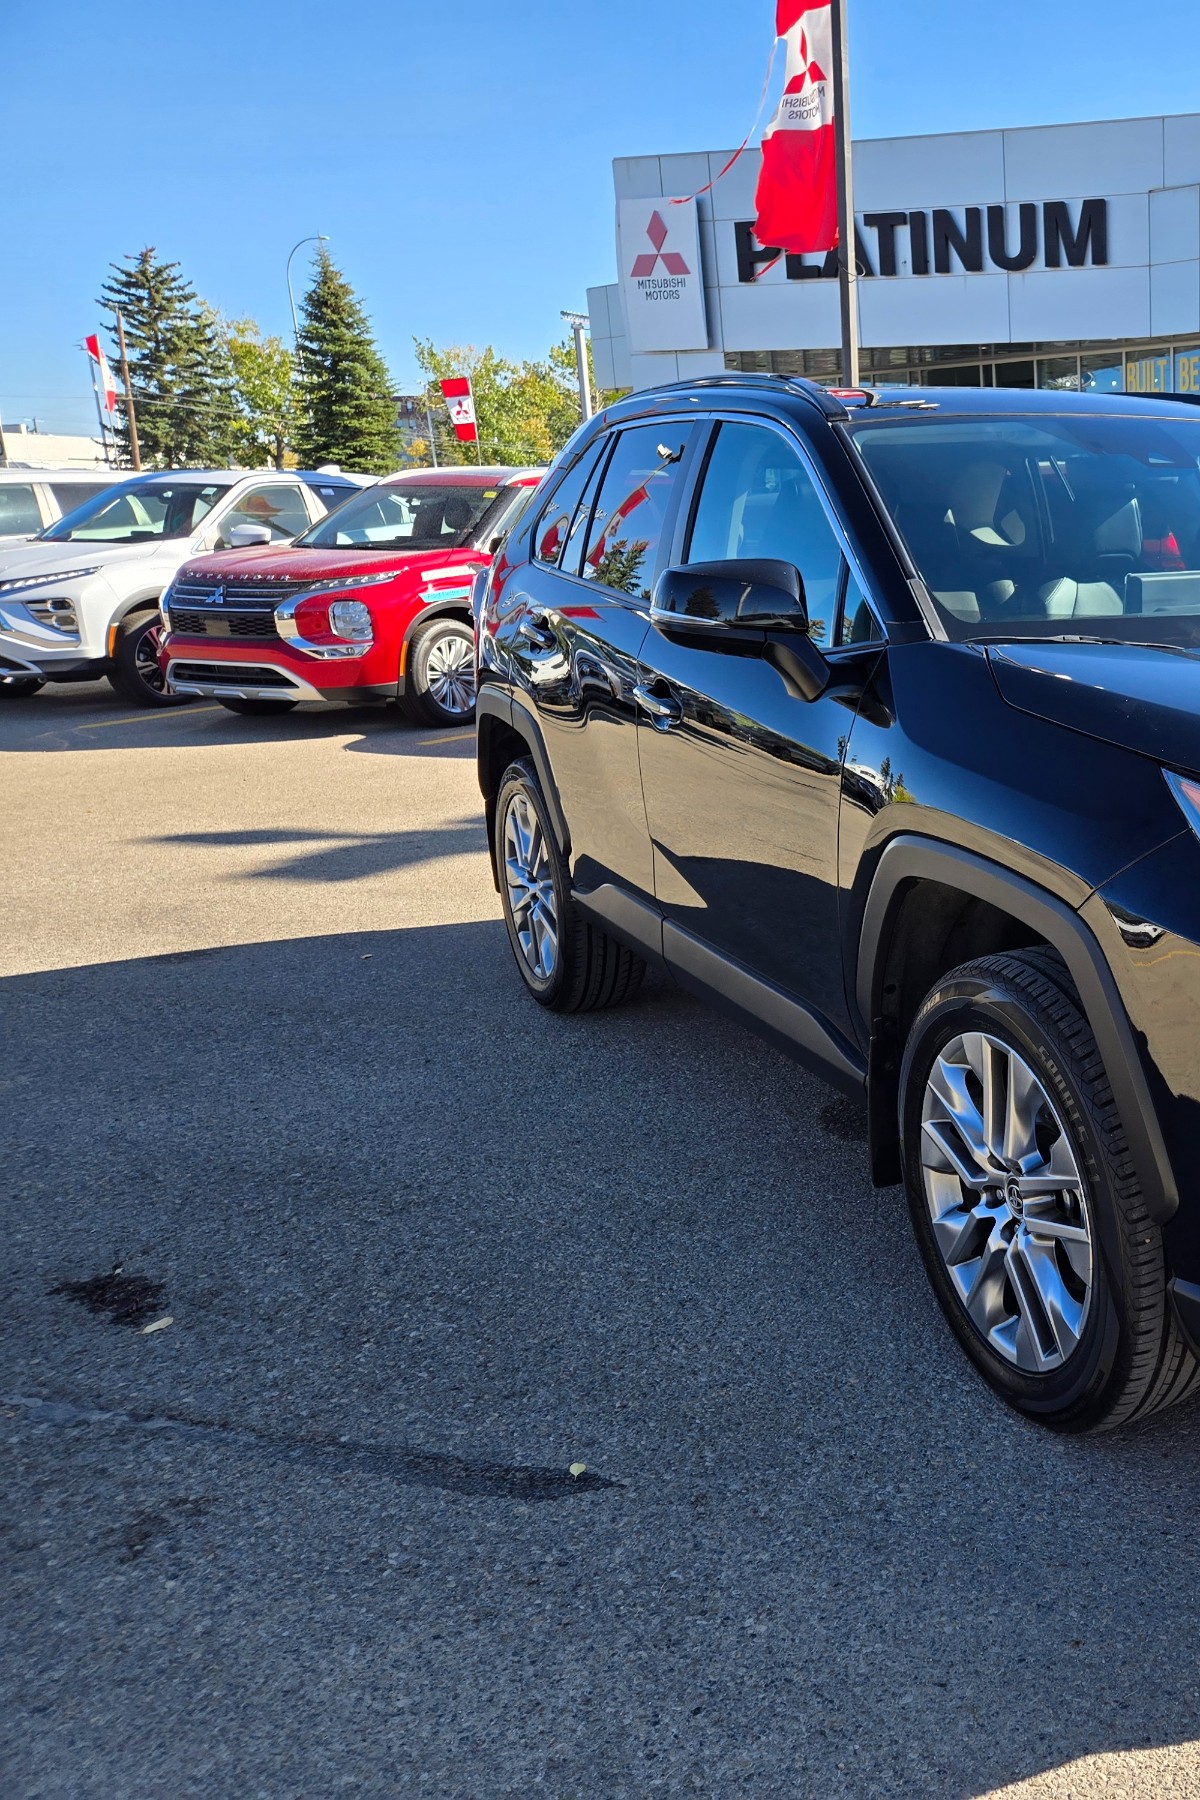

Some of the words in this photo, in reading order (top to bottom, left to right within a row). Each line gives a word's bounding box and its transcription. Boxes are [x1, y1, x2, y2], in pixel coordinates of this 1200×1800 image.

[637, 278, 686, 290] MITSUBISHI
[645, 290, 680, 301] MOTORS
[1126, 359, 1167, 392] BUILT
[186, 569, 291, 581] OUTLANDER
